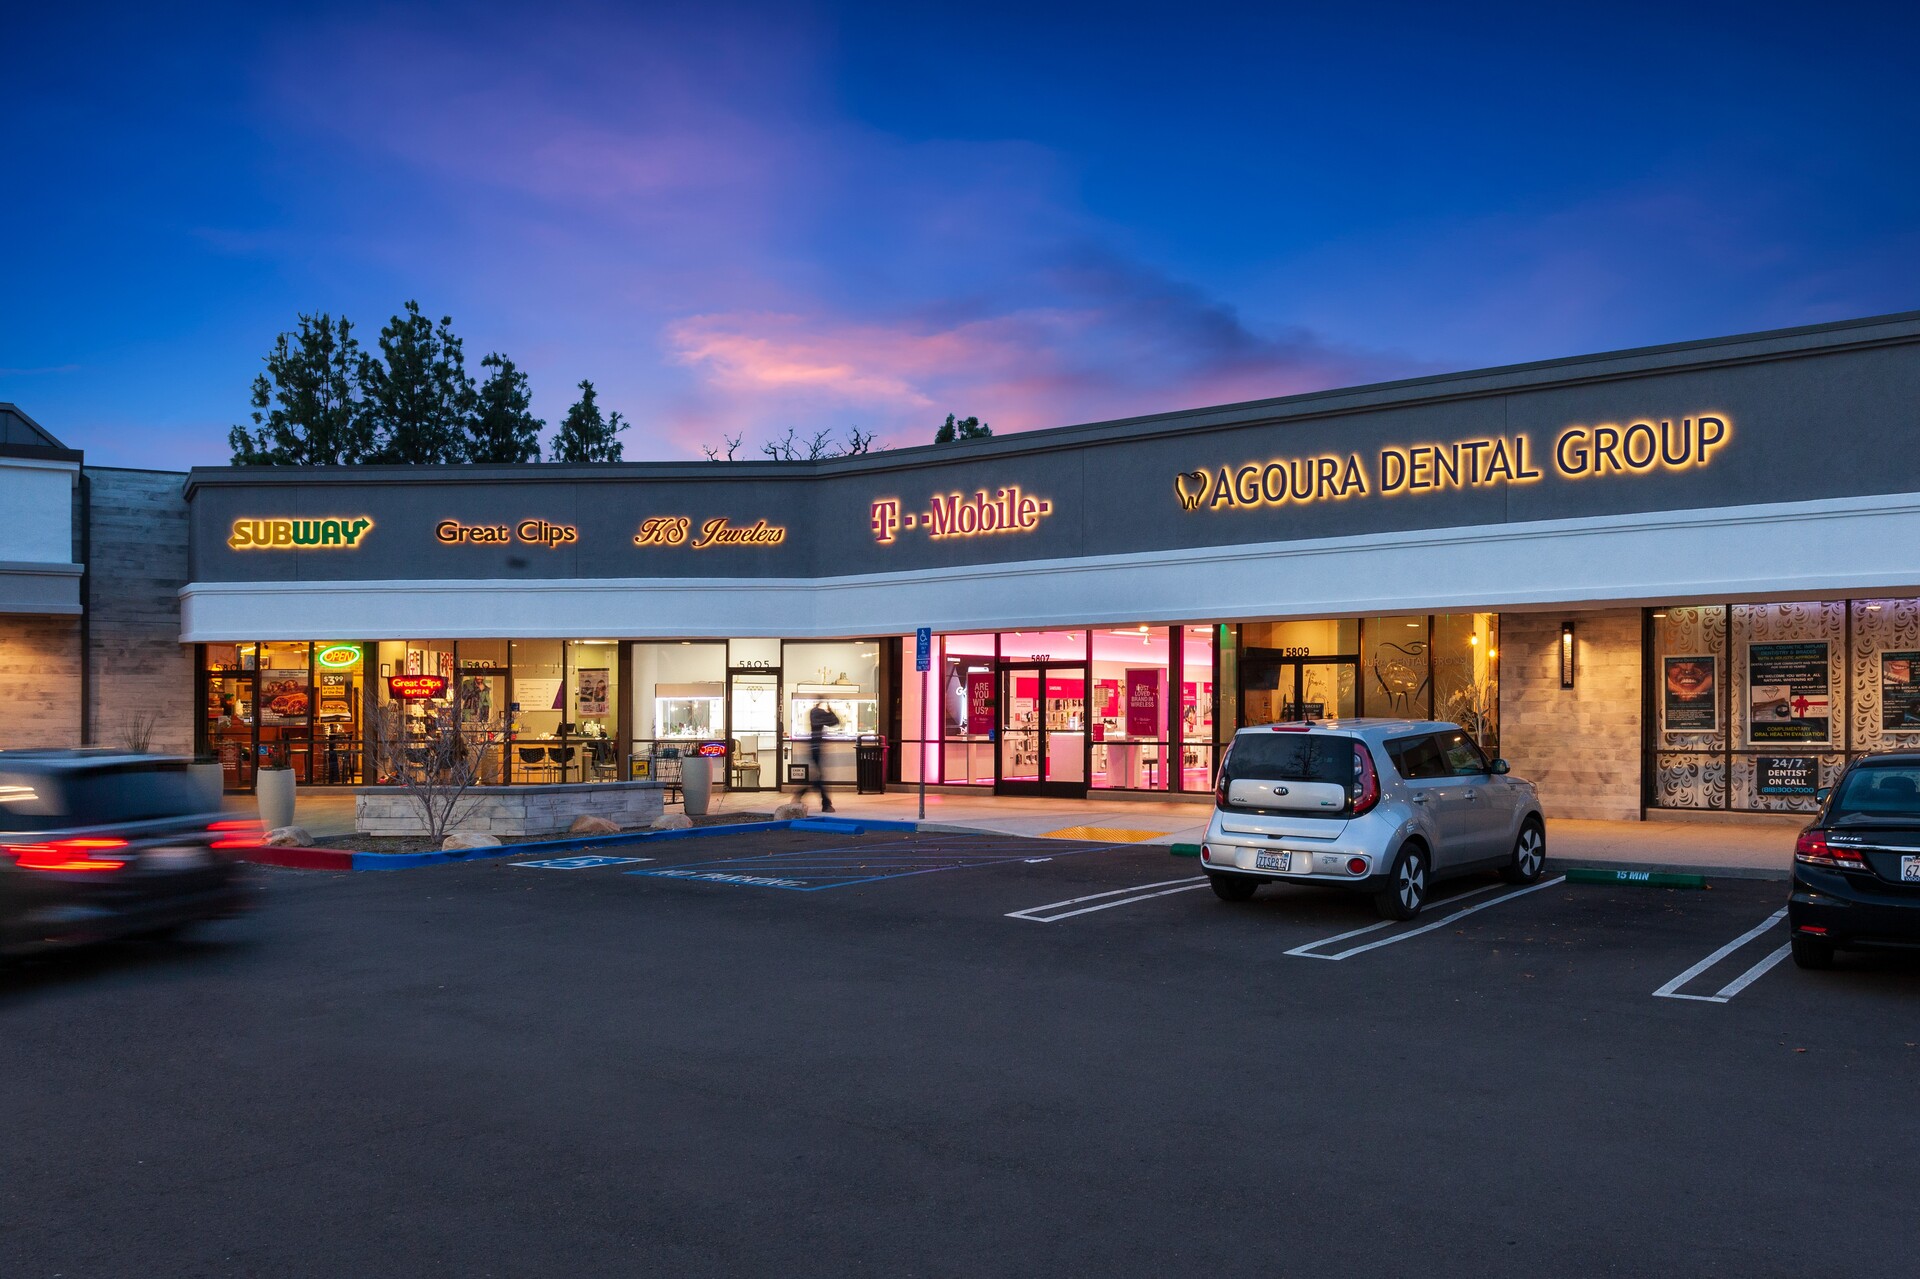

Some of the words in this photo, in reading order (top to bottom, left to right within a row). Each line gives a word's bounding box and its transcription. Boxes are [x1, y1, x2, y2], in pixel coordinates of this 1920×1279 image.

[1210, 454, 1366, 507] AGOURA
[1381, 437, 1539, 492] DENTAL
[1556, 416, 1725, 475] GROUP
[227, 517, 371, 548] SUBWAY
[435, 521, 509, 542] Great
[517, 520, 575, 546] Clips
[634, 518, 689, 543] KS
[692, 518, 785, 547] Jewelers
[324, 651, 354, 662] OPEN
[1285, 647, 1310, 657] 5809
[739, 660, 770, 668] 5805
[392, 678, 418, 687] Great
[419, 678, 442, 688] Clips
[974, 682, 989, 690] ARE
[974, 691, 990, 699] YOU
[975, 706, 989, 715] US?
[700, 745, 725, 755] OPEN
[1772, 758, 1803, 769] 24/7
[1767, 769, 1808, 777] DENTIST
[1784, 778, 1807, 786] CALL
[1616, 870, 1628, 879] 15
[1629, 871, 1650, 881] MIN
